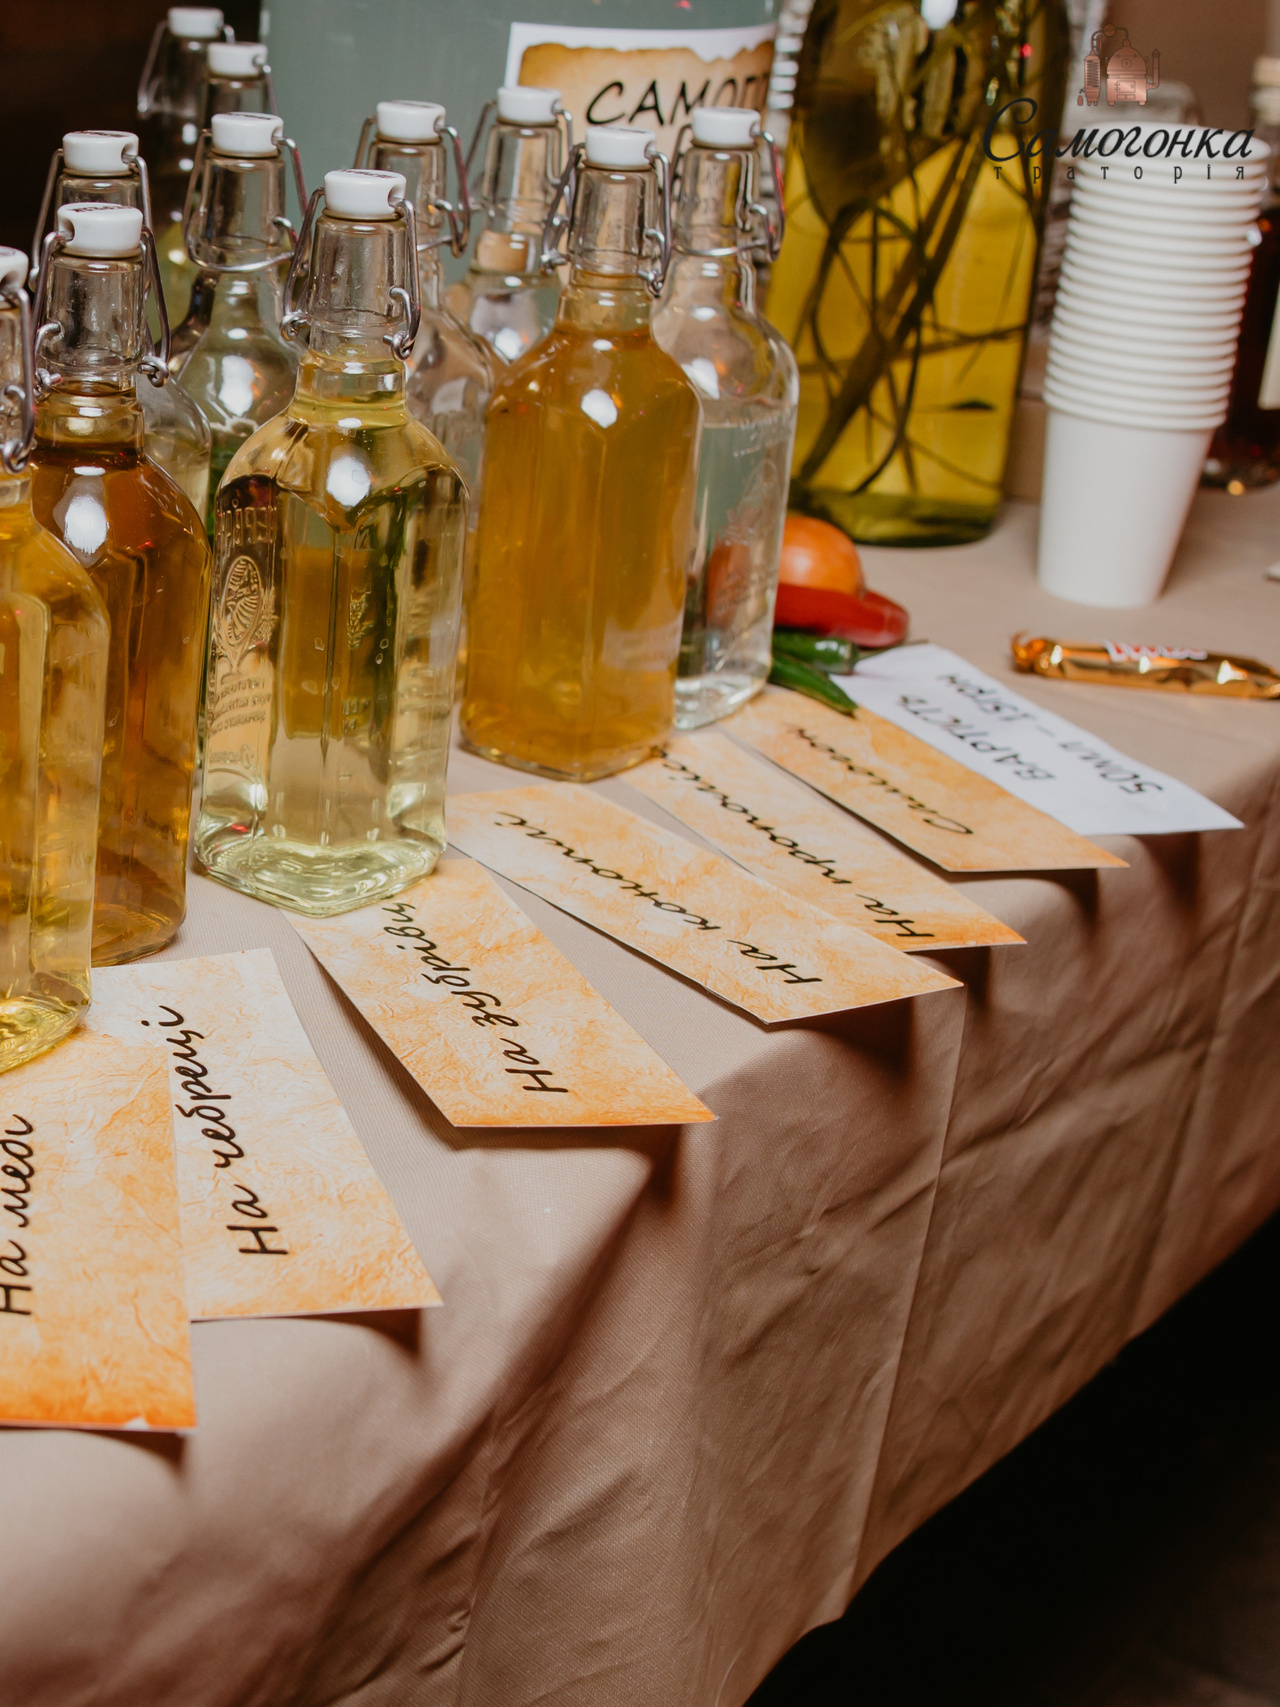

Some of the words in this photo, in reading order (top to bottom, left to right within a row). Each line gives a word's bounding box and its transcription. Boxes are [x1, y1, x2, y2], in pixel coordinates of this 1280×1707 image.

[494, 811, 722, 931] коноплі
[855, 893, 936, 938] На
[380, 894, 520, 1028] зубрівц
[726, 939, 823, 984] На
[140, 1004, 245, 1170] чебреці
[500, 1037, 569, 1093] На
[225, 1183, 290, 1256] На
